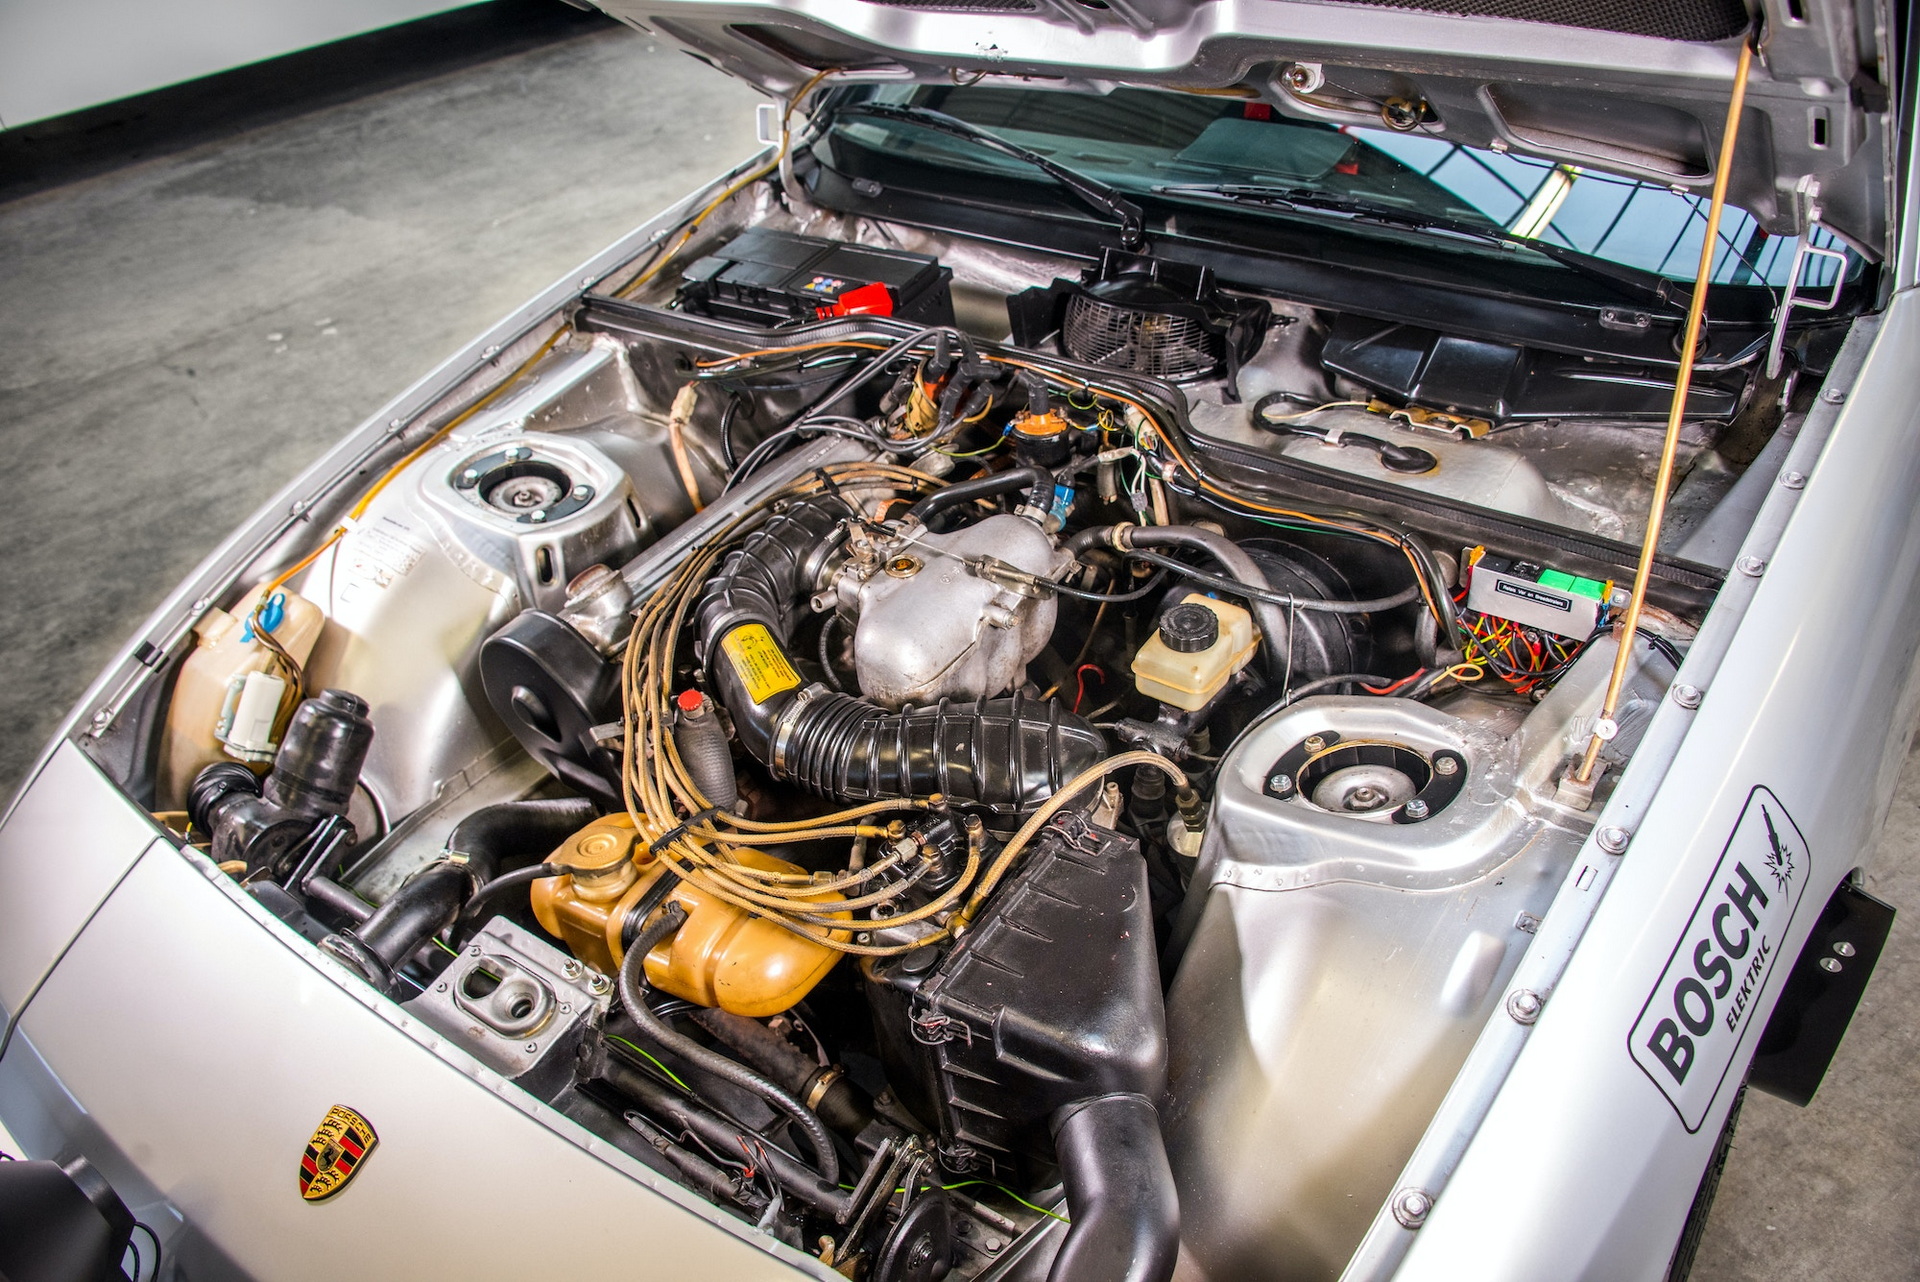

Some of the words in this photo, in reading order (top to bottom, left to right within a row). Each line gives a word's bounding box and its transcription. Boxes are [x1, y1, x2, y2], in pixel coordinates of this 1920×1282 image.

[1647, 861, 1769, 1086] BOSCH
[1726, 935, 1771, 1033] ELEKTRIC
[331, 1108, 371, 1143] PORSCHE
